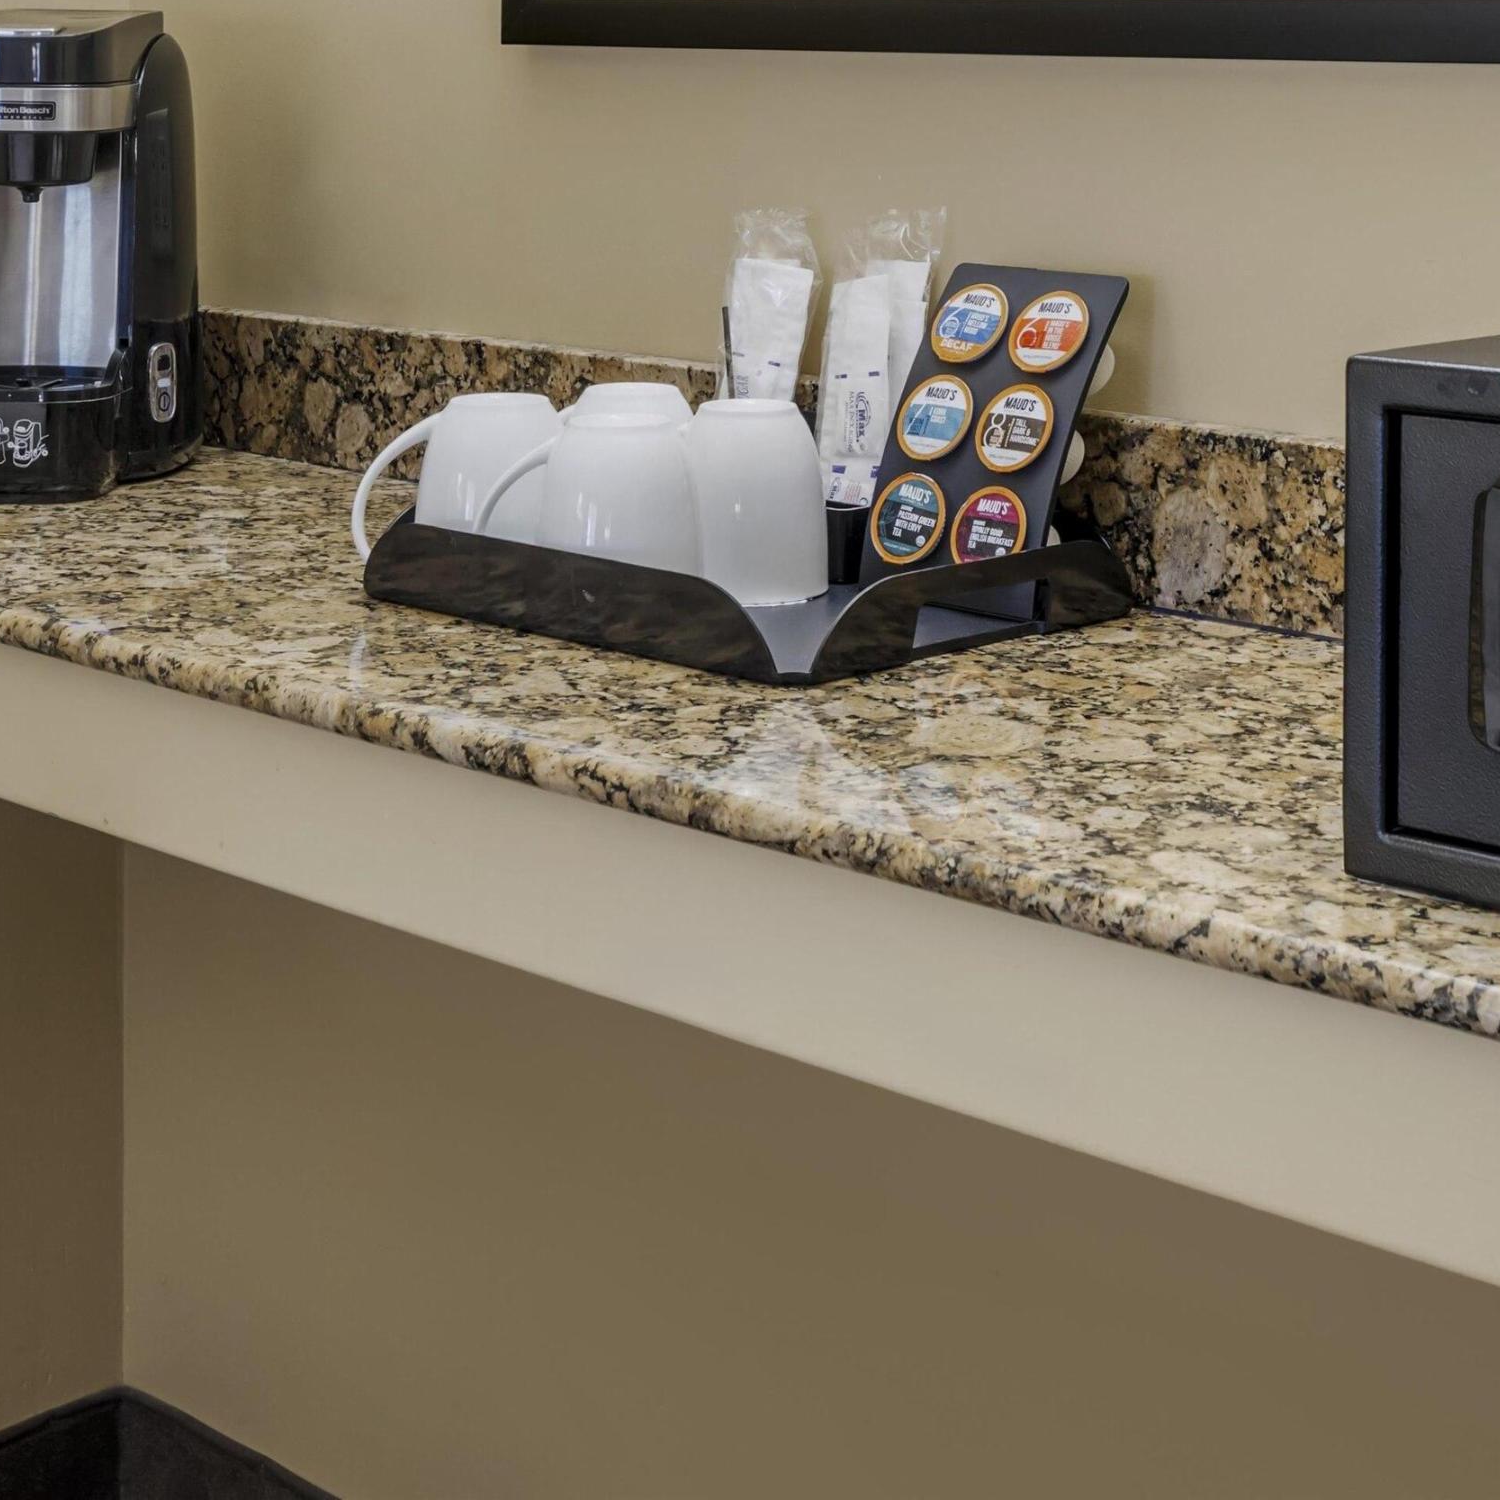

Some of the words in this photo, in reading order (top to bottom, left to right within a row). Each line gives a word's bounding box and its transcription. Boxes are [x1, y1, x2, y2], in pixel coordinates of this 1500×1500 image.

[20, 106, 50, 115] Beach
[963, 293, 995, 309] MAUD'S
[1038, 302, 1073, 314] MAUD'S
[925, 386, 958, 401] MAUD'S
[1004, 396, 1037, 412] MAUD'S
[858, 409, 866, 437] Max
[898, 483, 932, 504] MAUD'S
[977, 498, 1009, 516] MAUD'S
